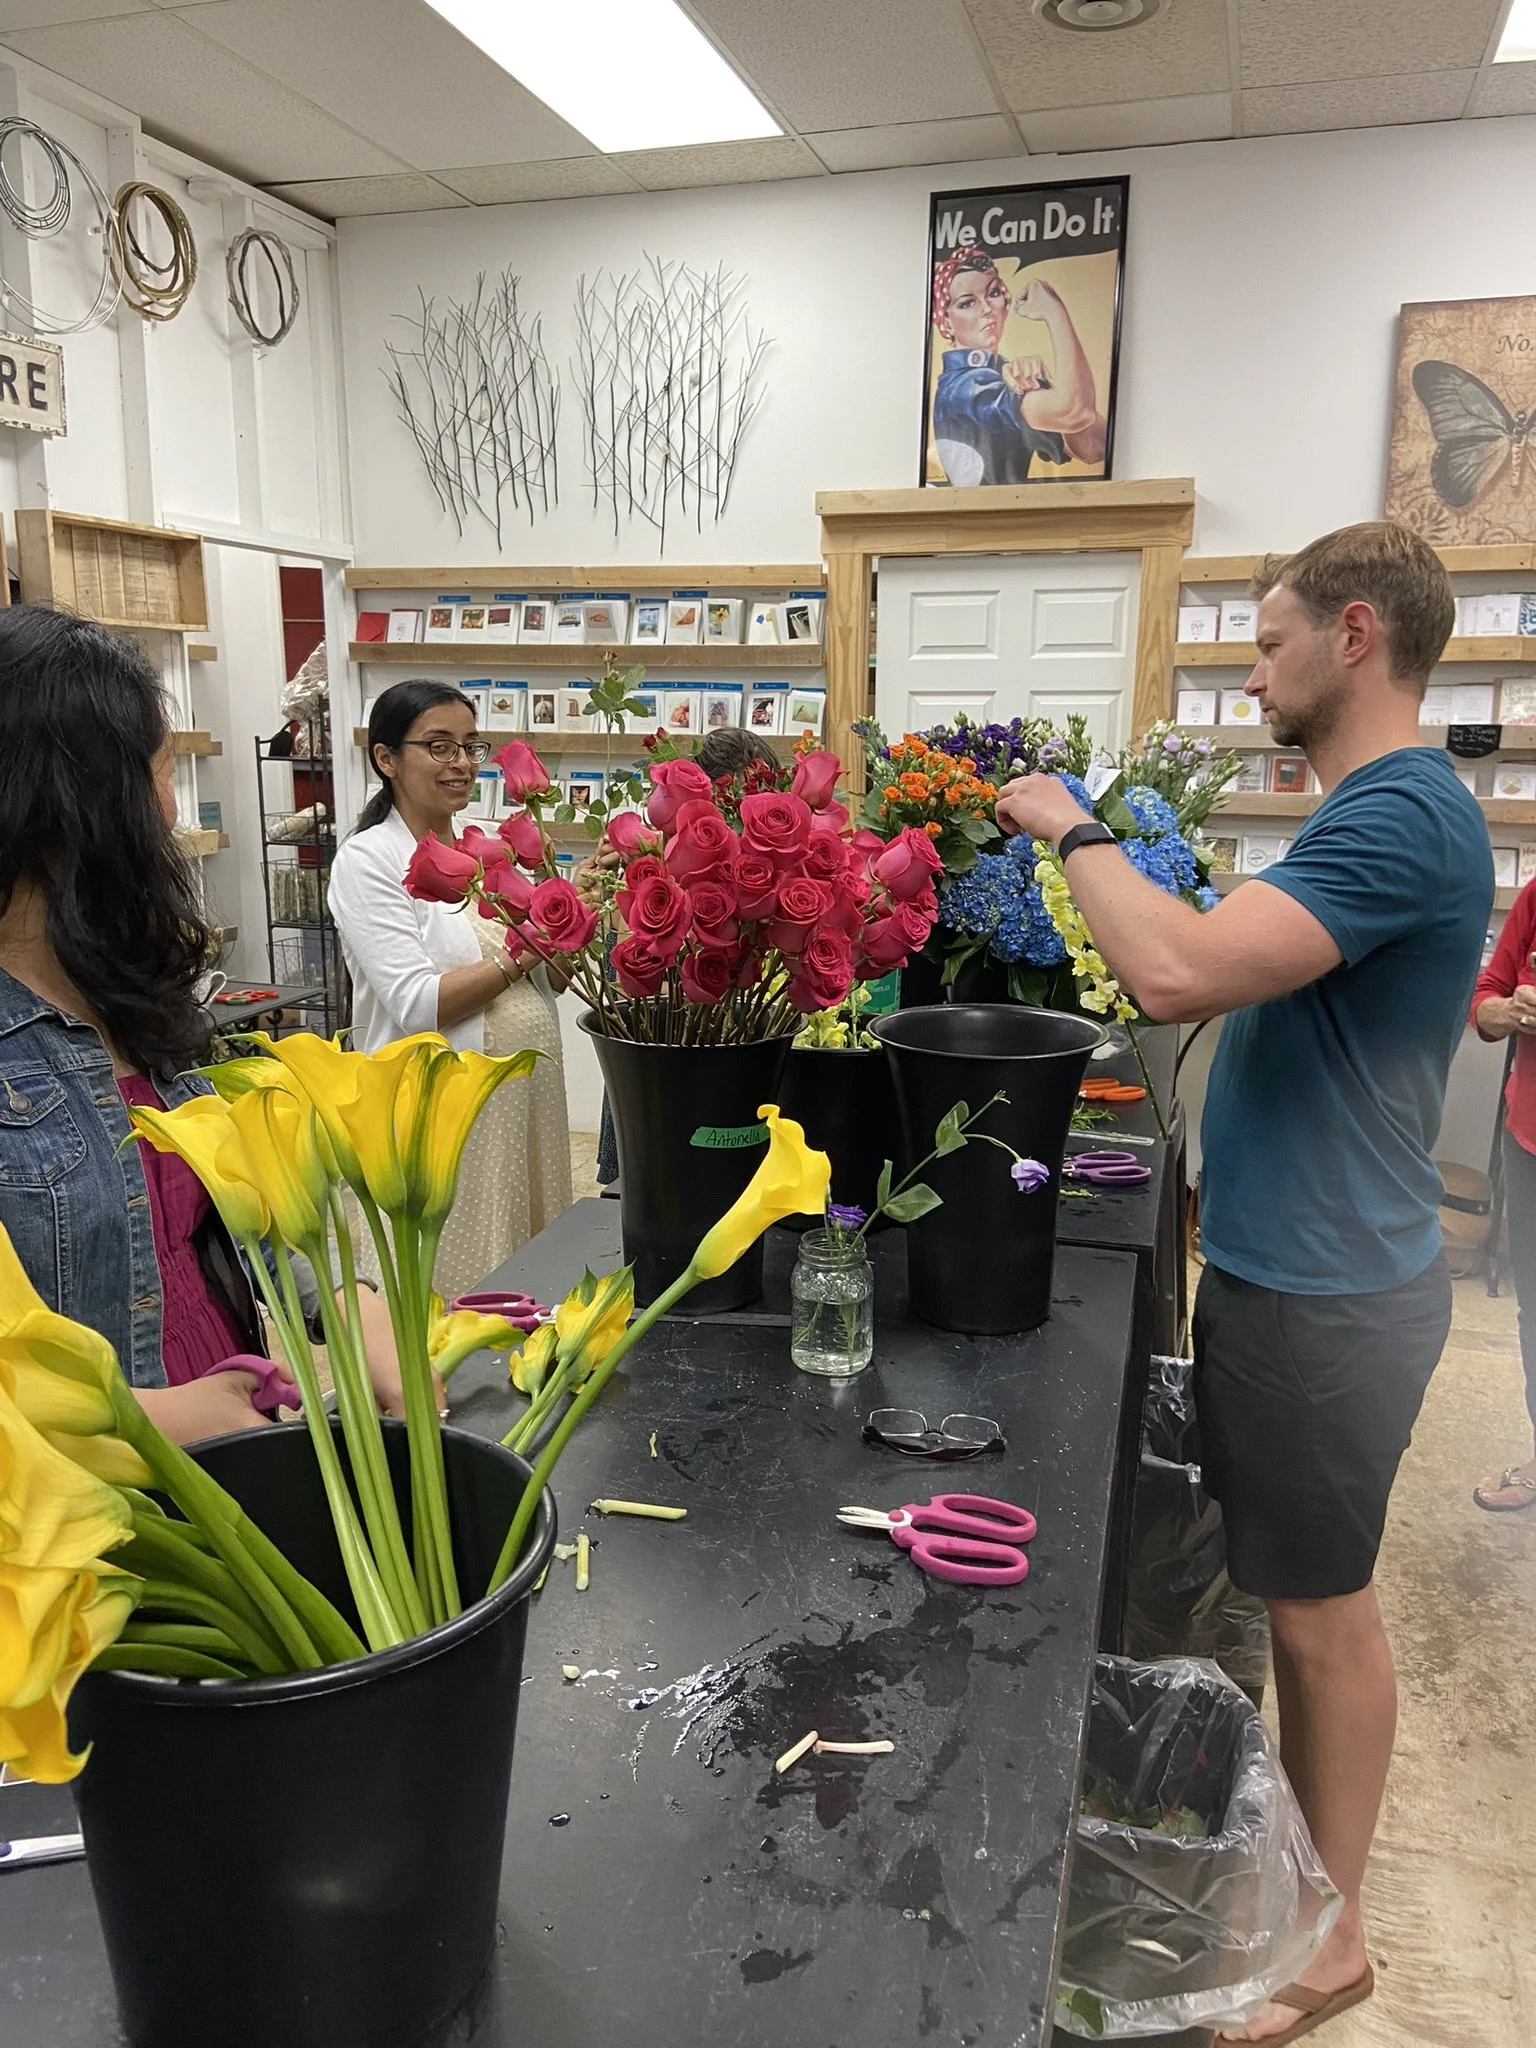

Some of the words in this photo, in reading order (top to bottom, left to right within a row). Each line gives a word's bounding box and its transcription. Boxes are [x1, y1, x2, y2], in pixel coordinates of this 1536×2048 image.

[935, 210, 976, 249] We
[981, 207, 1036, 246] Can
[1043, 201, 1086, 241] Do
[705, 1128, 761, 1147] Antonella
